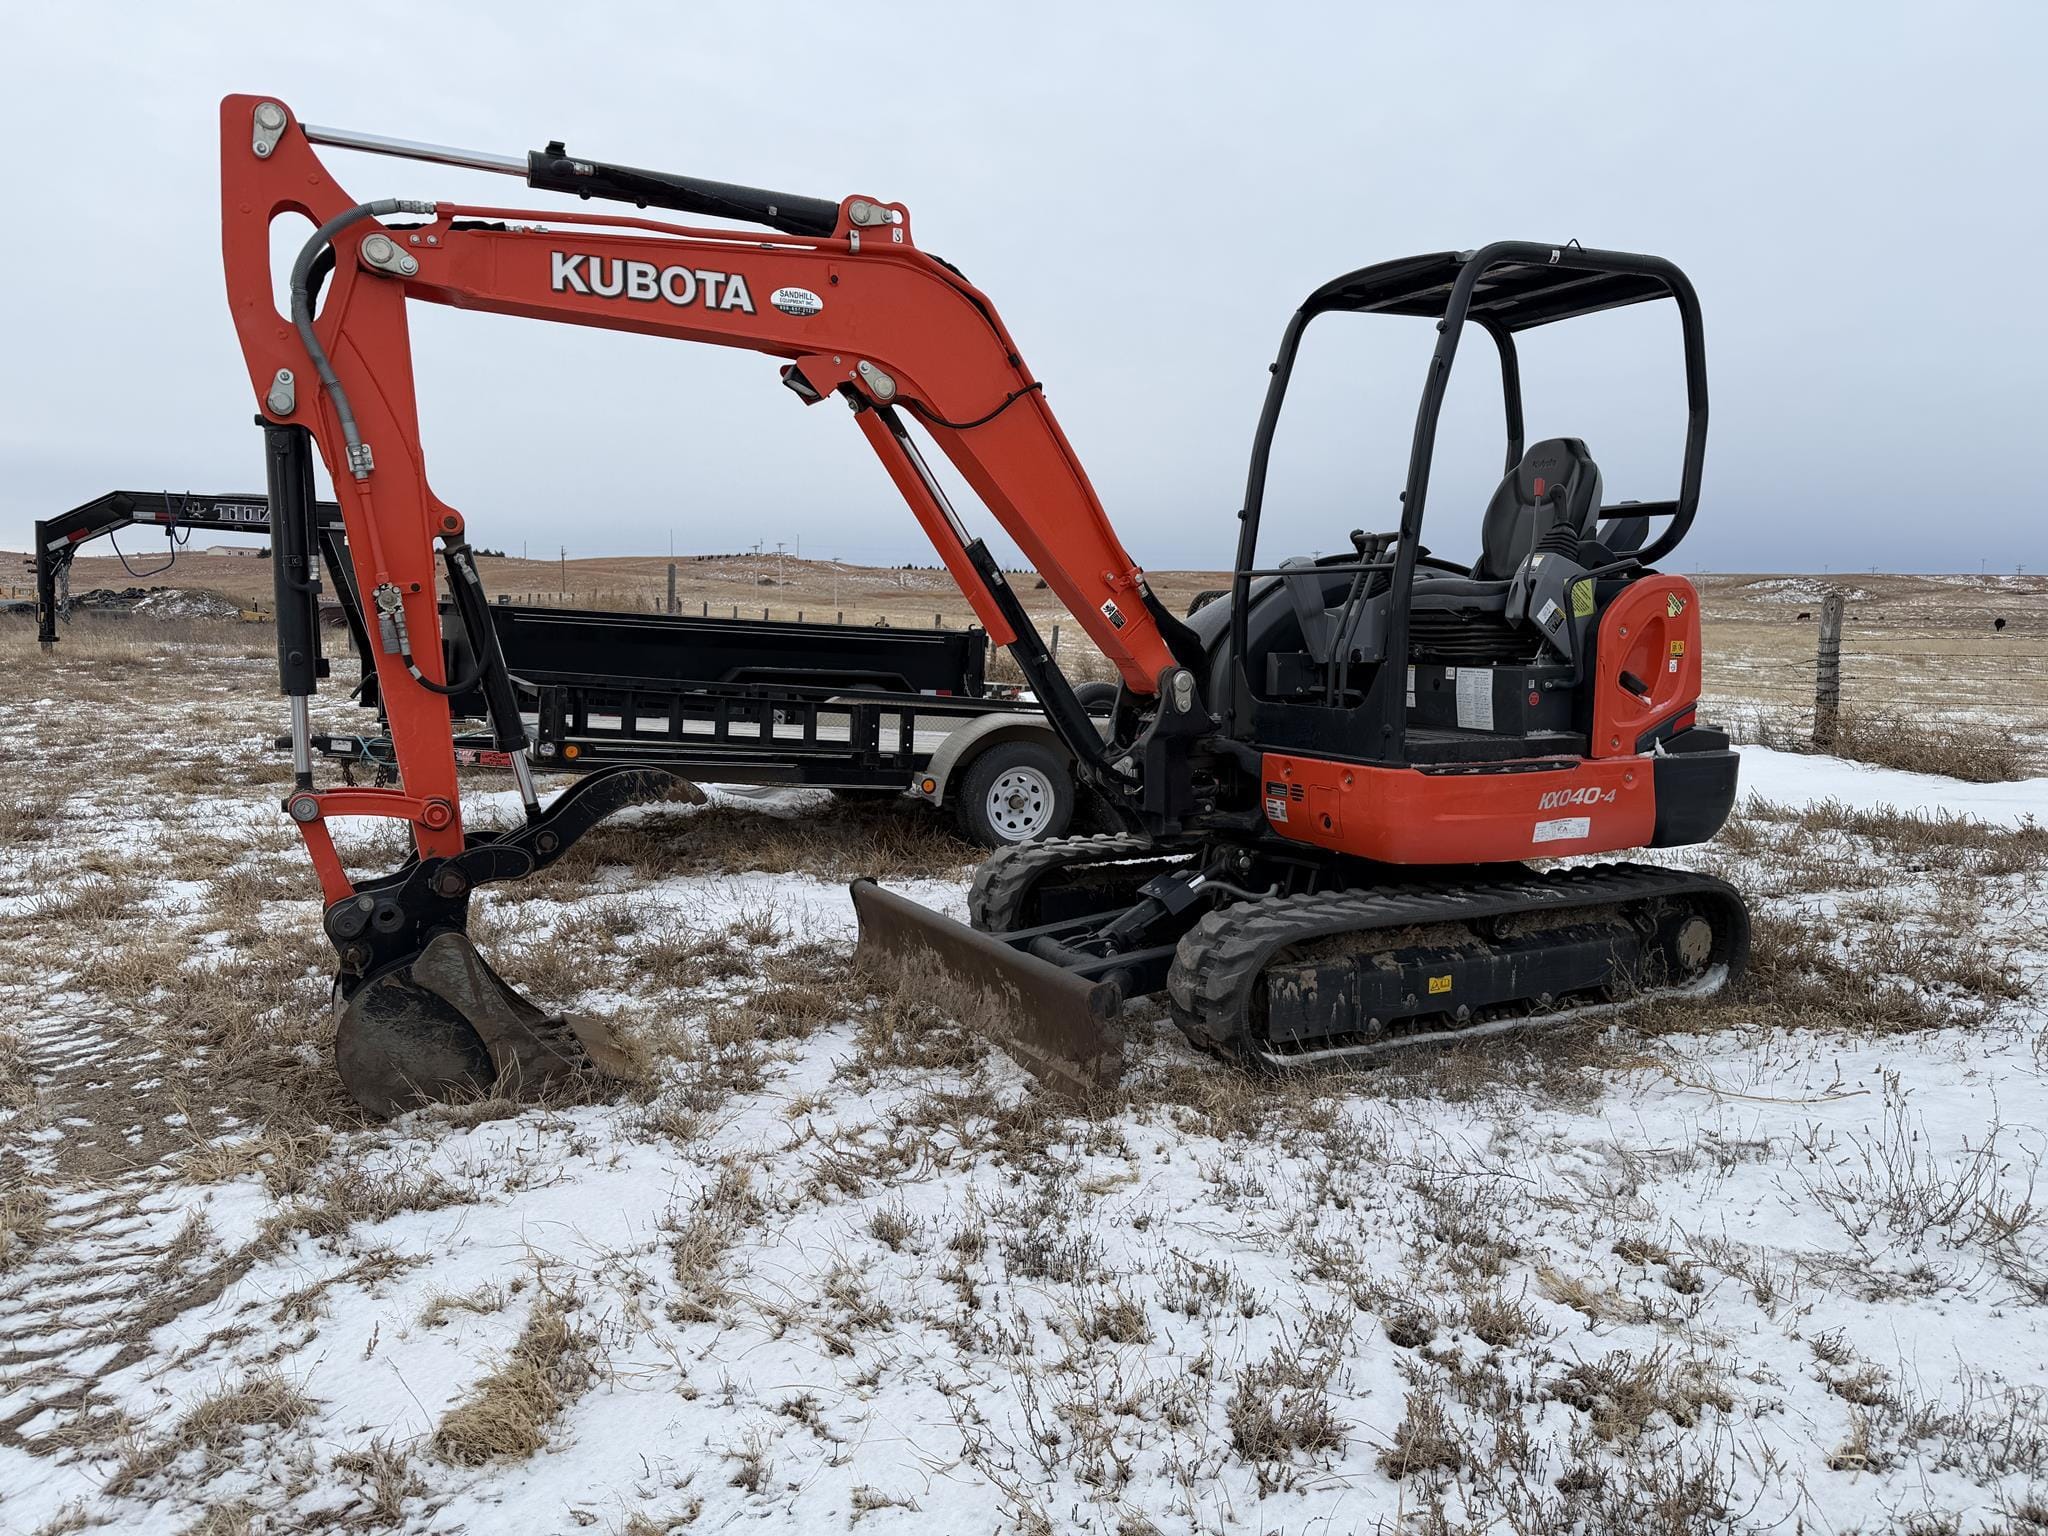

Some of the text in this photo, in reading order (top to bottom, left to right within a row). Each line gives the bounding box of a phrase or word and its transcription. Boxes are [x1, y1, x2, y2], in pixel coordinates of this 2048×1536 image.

[551, 251, 756, 313] KUBOTA
[779, 289, 814, 301] SANDHILL
[779, 297, 805, 305] EQUIPMENT
[1538, 787, 1617, 810] KX040-4
